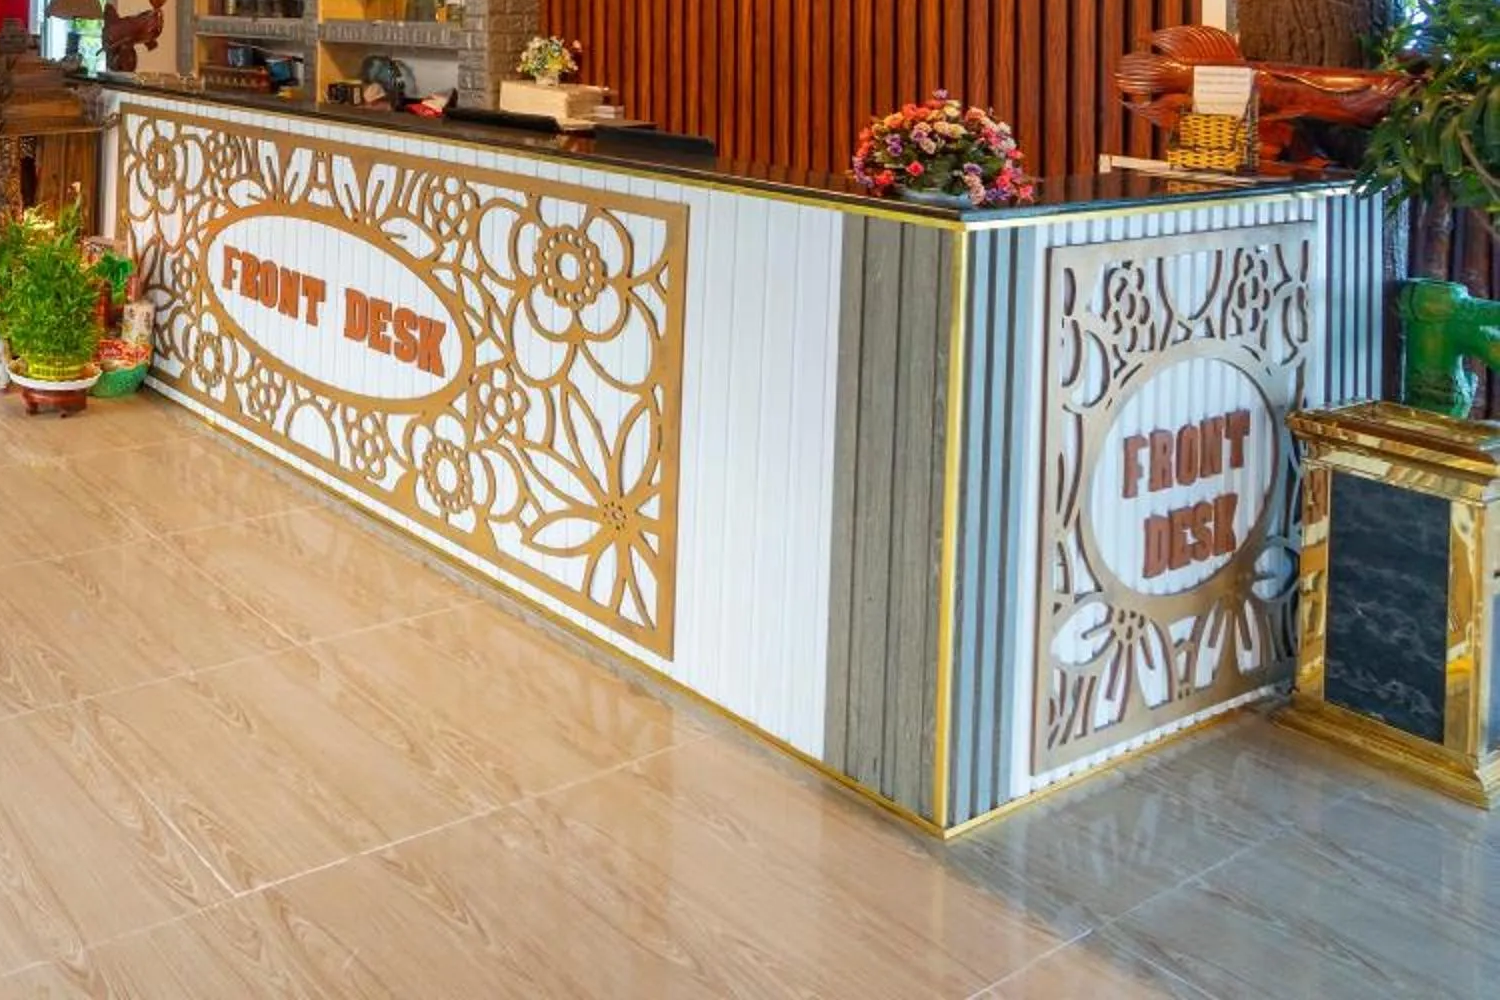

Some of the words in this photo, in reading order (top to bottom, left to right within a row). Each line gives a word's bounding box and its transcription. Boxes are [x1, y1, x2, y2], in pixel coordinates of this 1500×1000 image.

[222, 245, 326, 327] FRONT
[343, 288, 447, 378] DESK
[1122, 409, 1251, 499] FRONT
[1143, 492, 1238, 579] DESK
